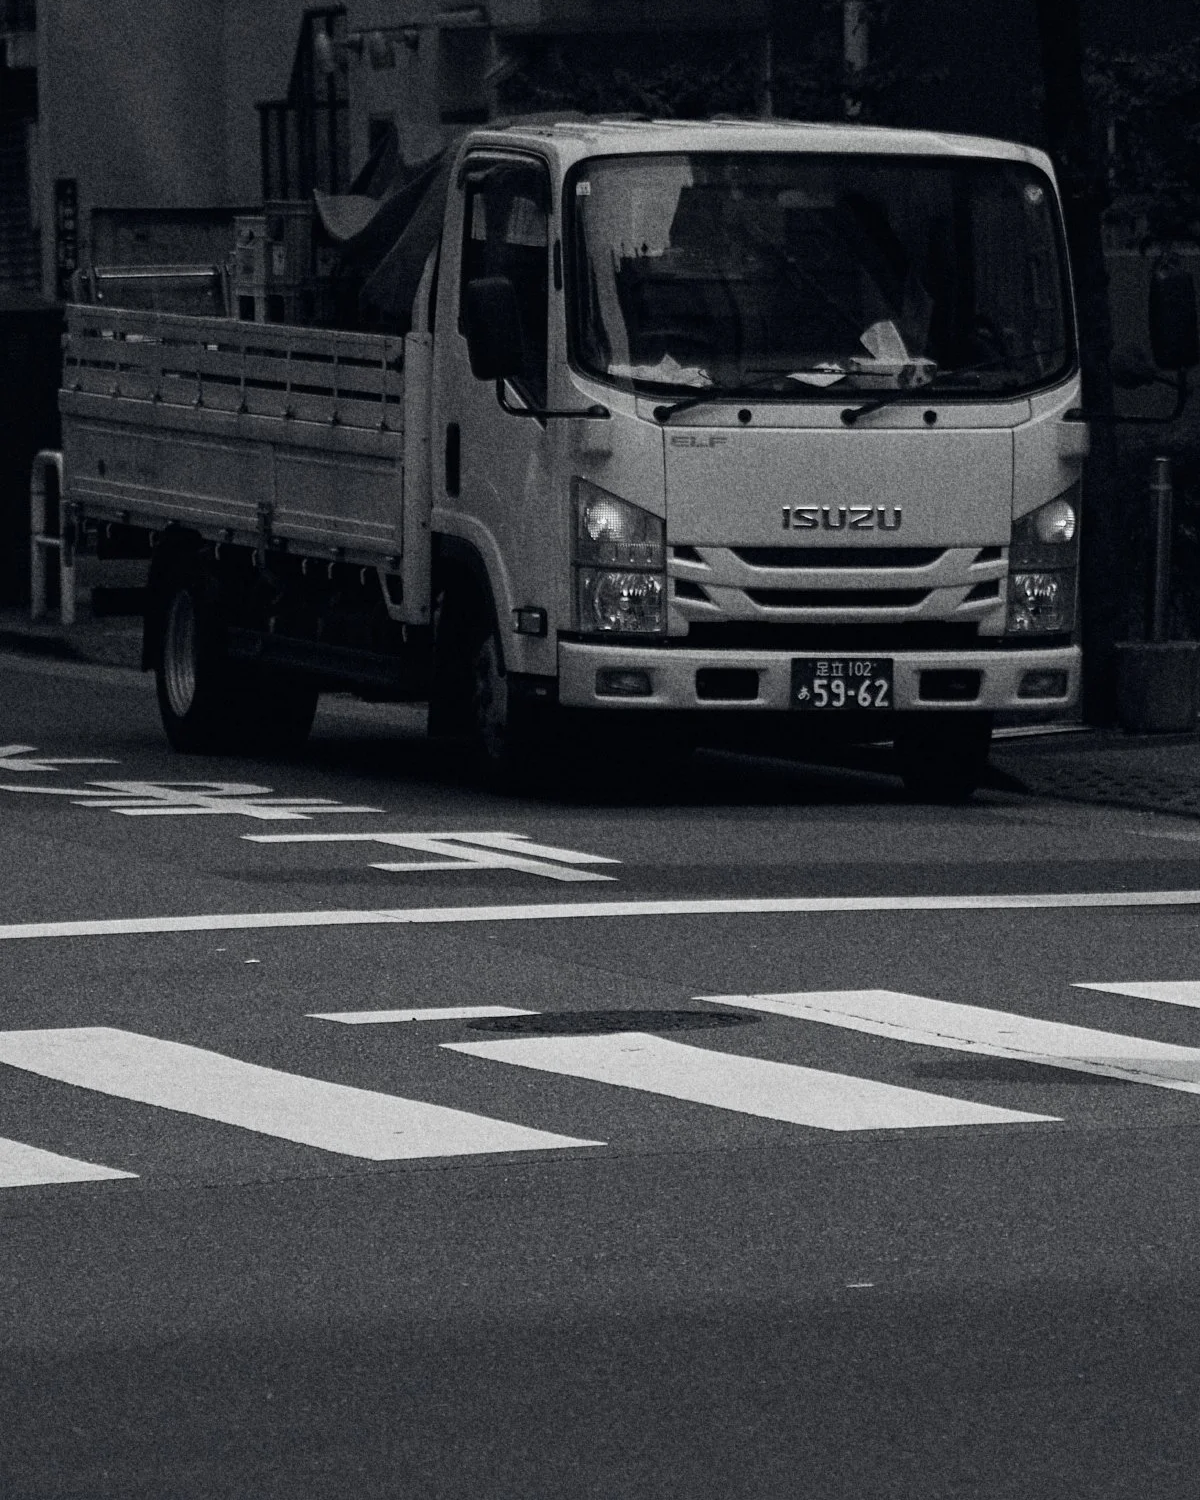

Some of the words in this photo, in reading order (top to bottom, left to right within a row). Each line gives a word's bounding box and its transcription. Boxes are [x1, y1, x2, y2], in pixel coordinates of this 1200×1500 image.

[670, 435, 728, 448] ELF
[781, 505, 903, 531] ISUZU
[815, 661, 844, 677] 足立
[848, 661, 872, 677] 102
[797, 685, 811, 701] あ
[812, 679, 890, 708] 59-62
